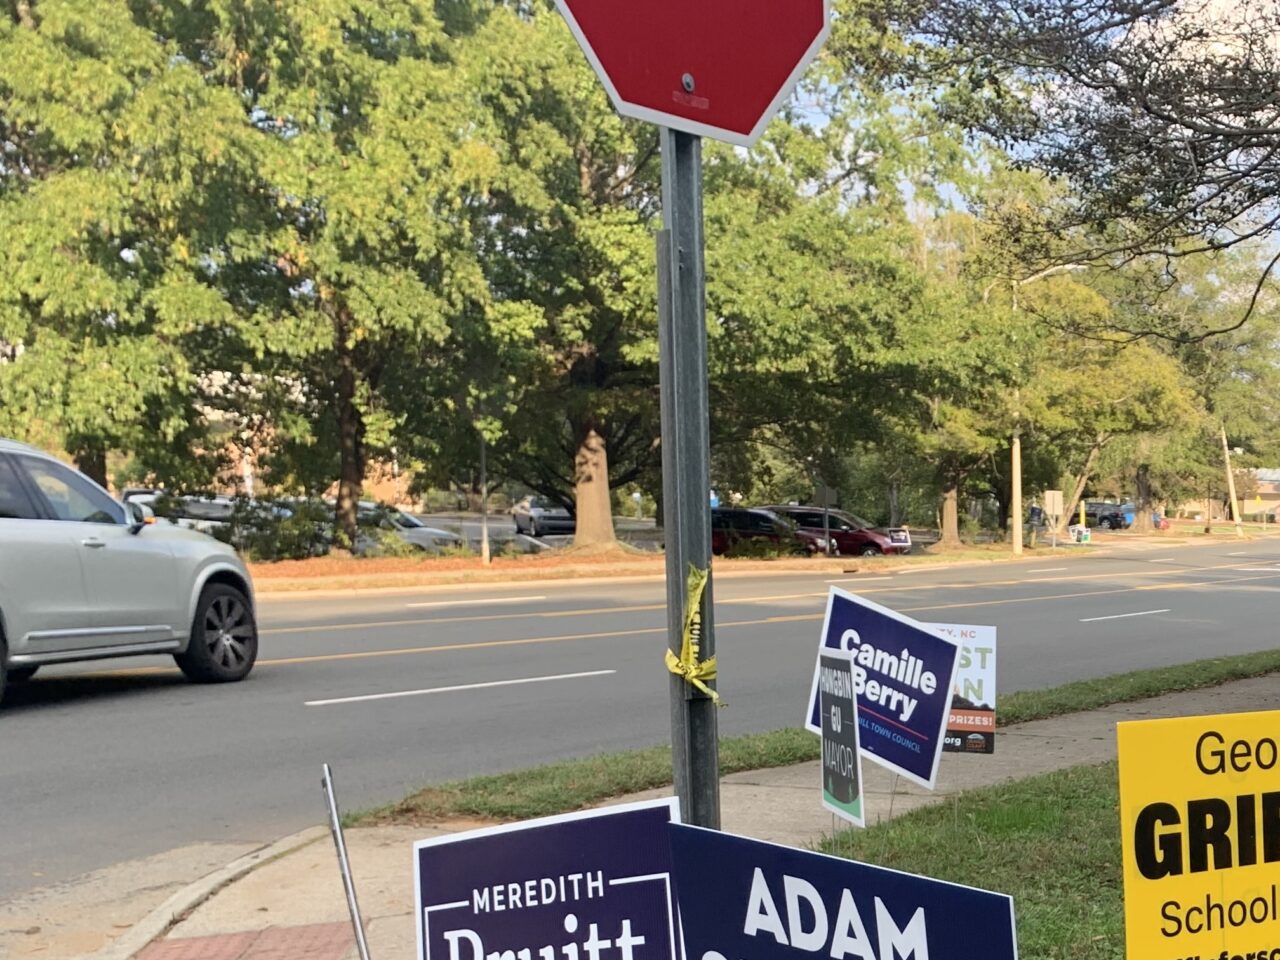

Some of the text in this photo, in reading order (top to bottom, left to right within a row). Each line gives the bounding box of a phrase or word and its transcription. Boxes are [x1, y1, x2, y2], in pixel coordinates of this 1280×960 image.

[840, 628, 938, 695] Camille
[853, 662, 918, 722] Berry
[830, 704, 842, 734] GU
[871, 722, 892, 739] TOWN
[892, 733, 921, 754] COUNCIL
[948, 714, 993, 726] PRIZES!
[824, 738, 855, 780] MAYOR
[473, 870, 604, 914] MEREDITH
[1160, 884, 1277, 937] School
